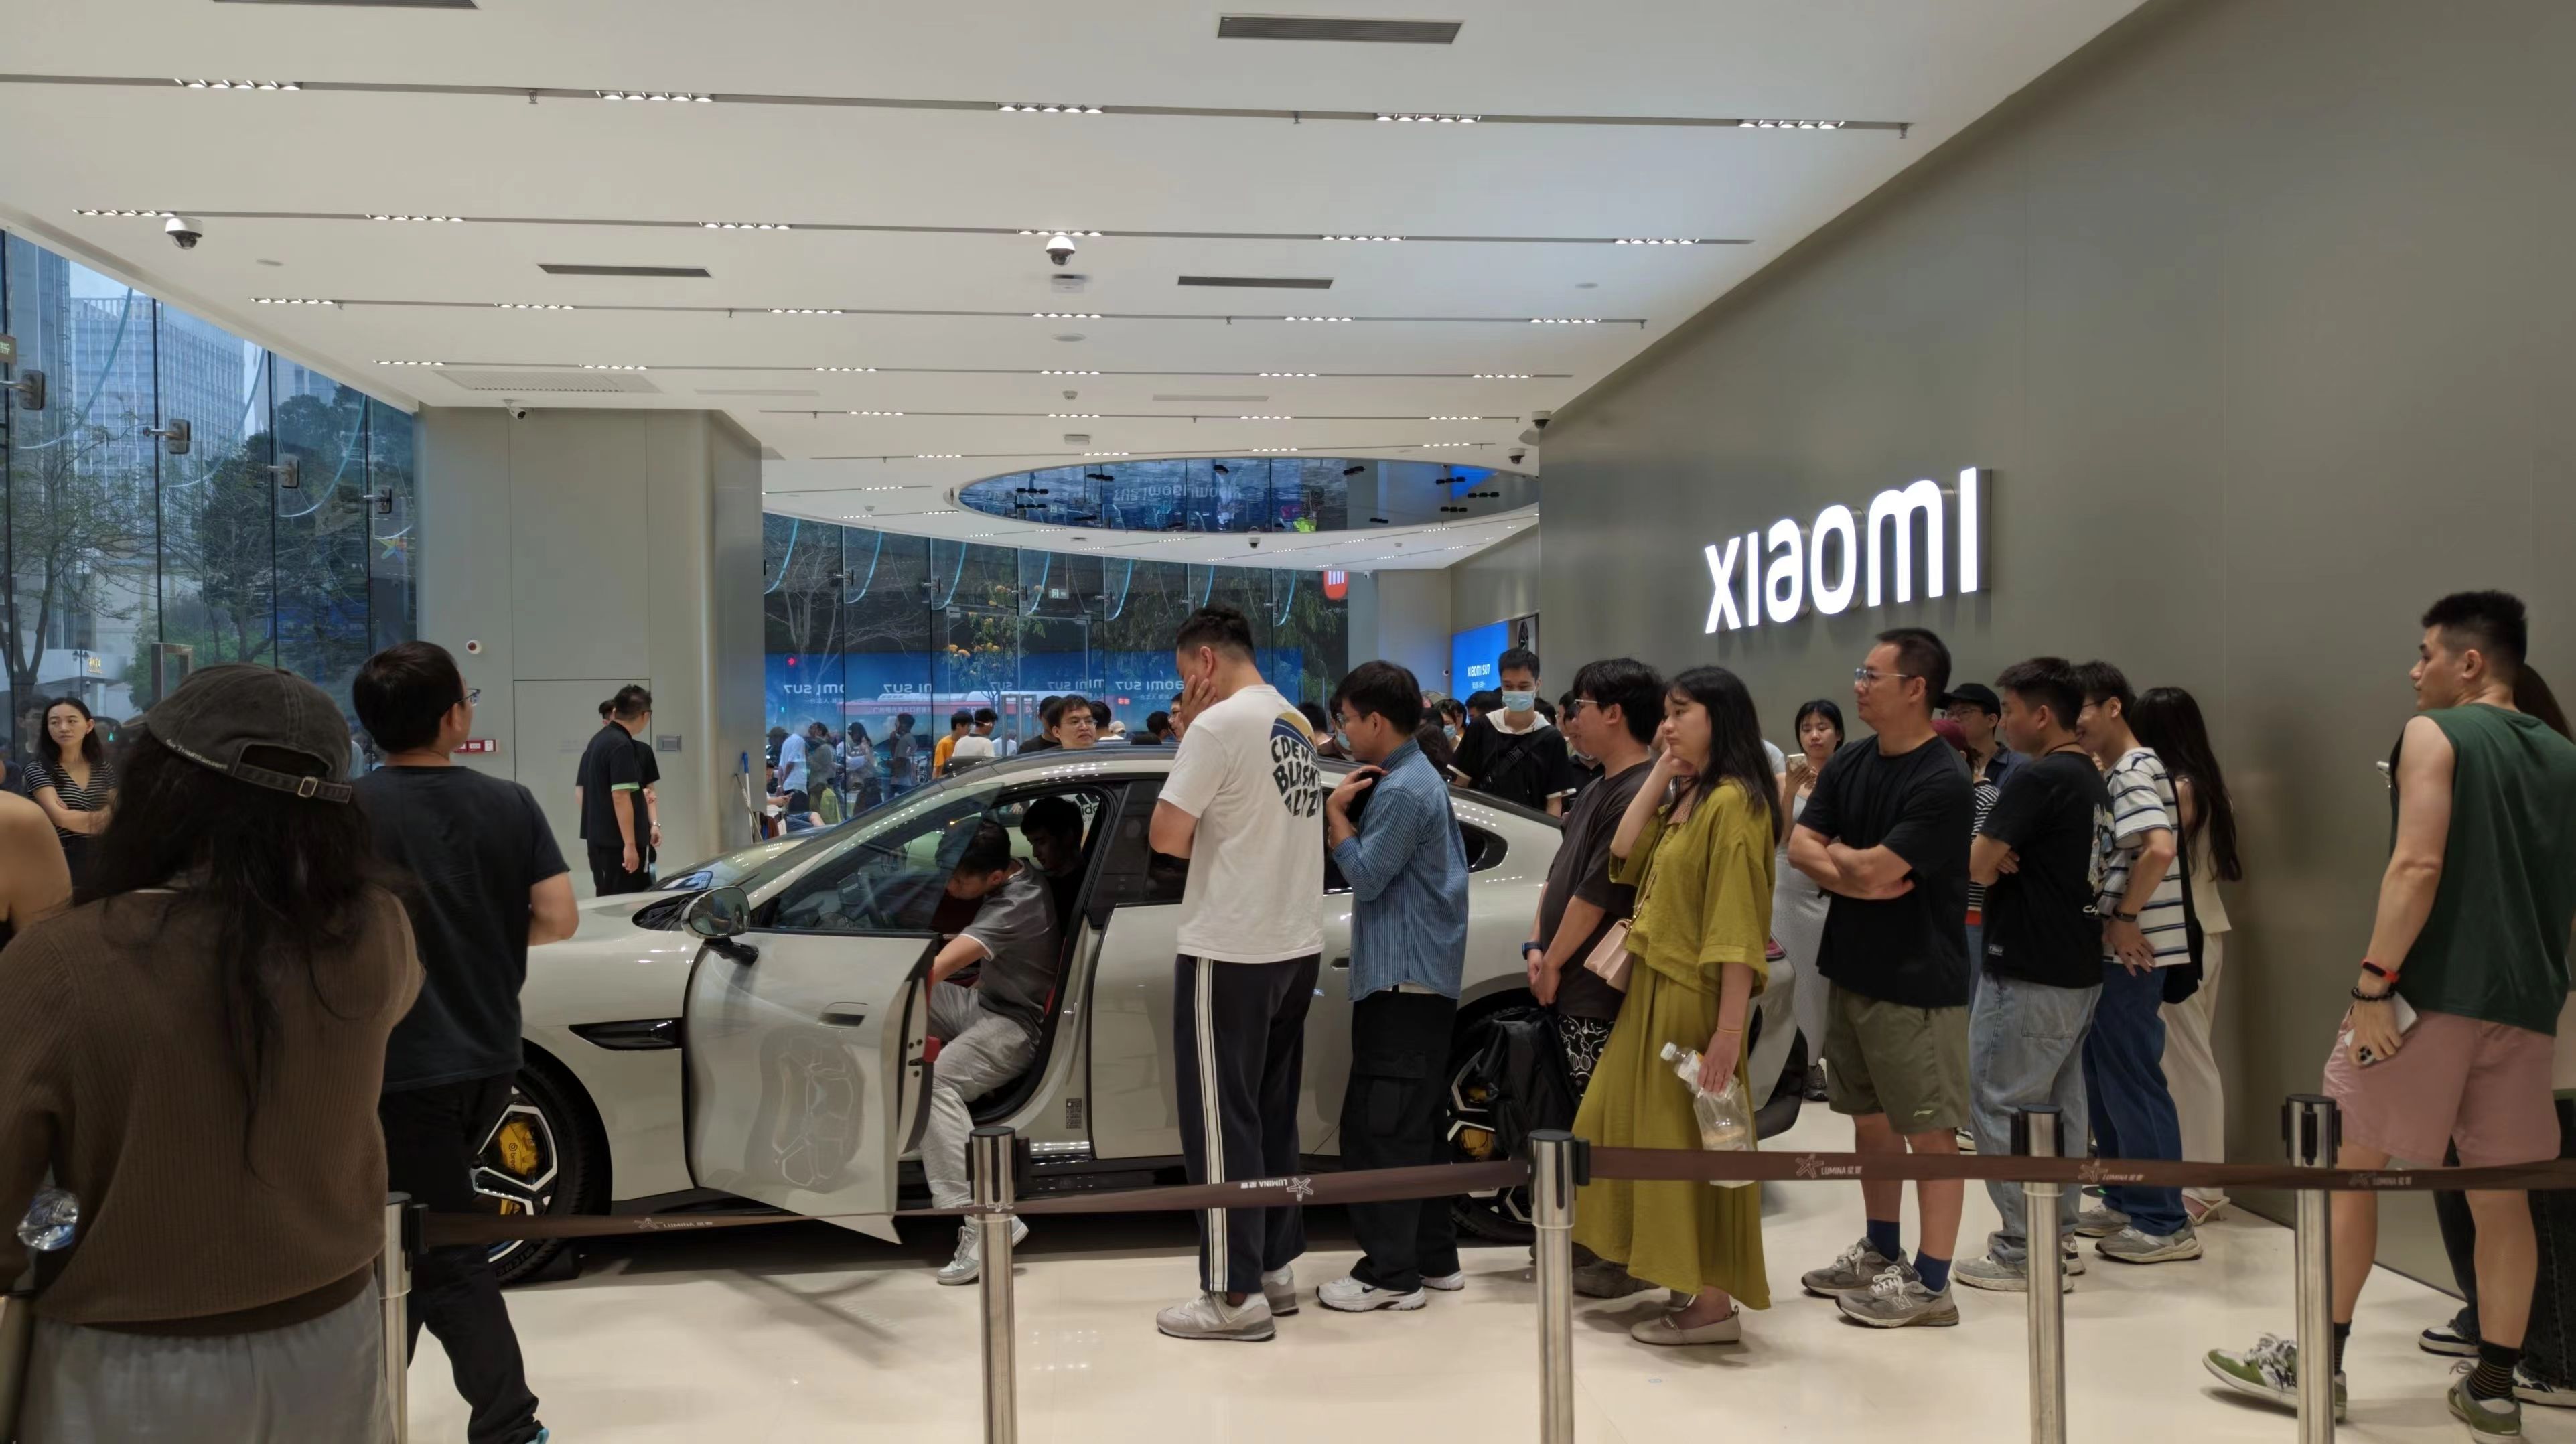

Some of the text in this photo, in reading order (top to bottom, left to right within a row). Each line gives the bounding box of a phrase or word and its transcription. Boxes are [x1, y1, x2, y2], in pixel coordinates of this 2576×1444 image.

[1705, 467, 1977, 634] xiaomi
[1821, 1166, 1845, 1175] LUMINA
[1259, 1179, 1288, 1187] LUMINA
